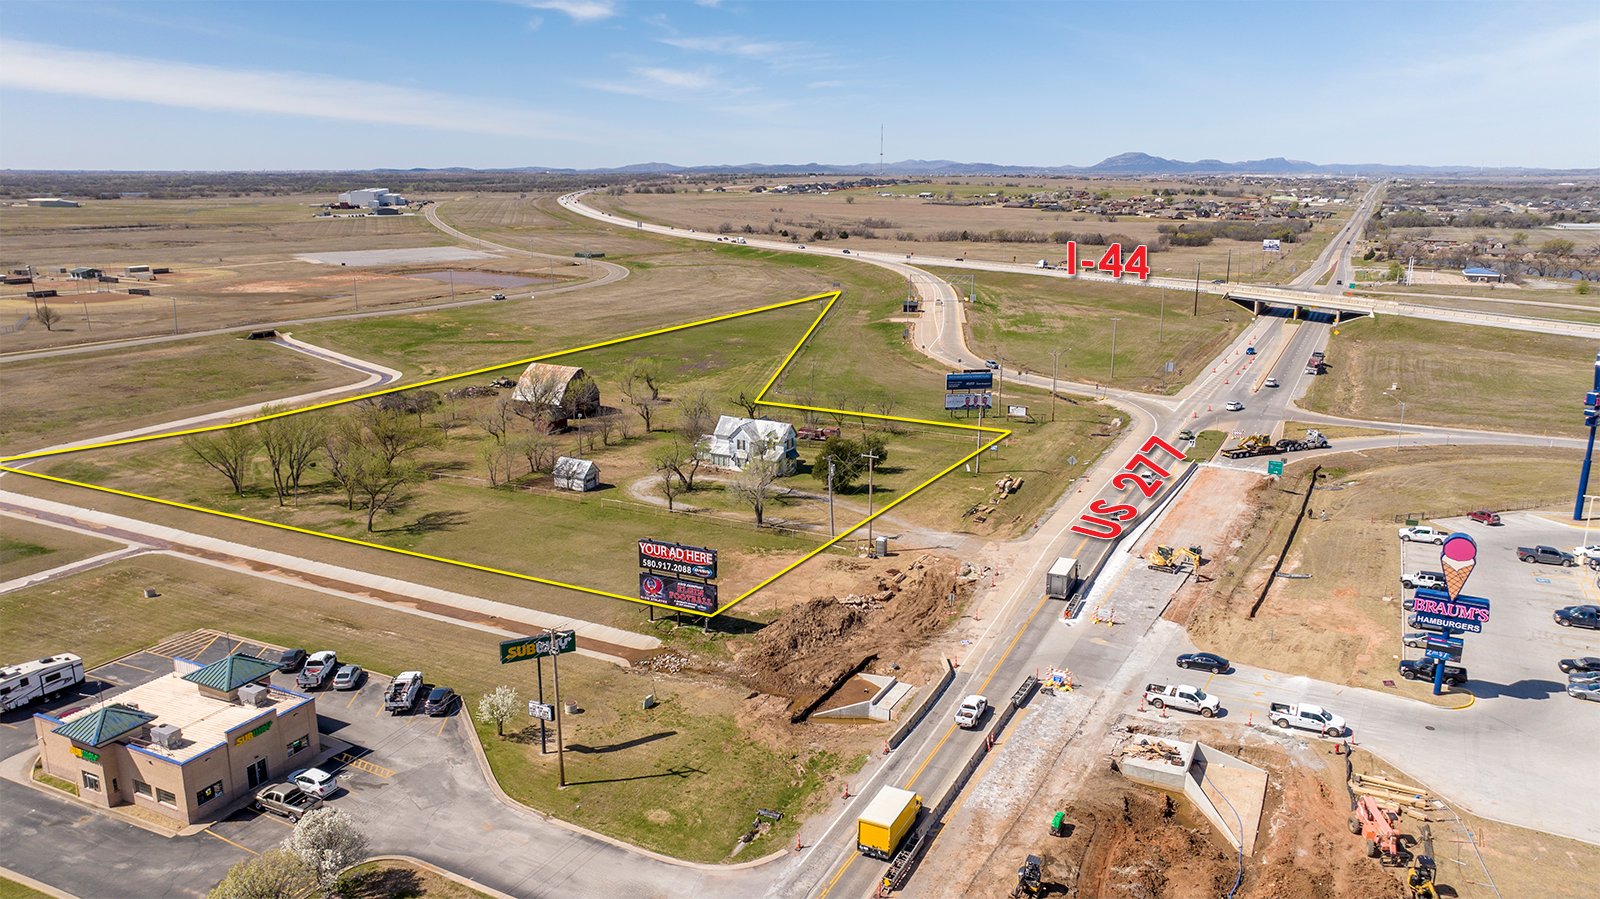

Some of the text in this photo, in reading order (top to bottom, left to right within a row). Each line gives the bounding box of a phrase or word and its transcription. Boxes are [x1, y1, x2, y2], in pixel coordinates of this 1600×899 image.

[639, 542, 713, 565] YOUR AD HERE
[643, 559, 691, 574] 580.917.2088
[669, 591, 713, 606] FOOTBALL
[1413, 598, 1489, 622] BRAUM'S
[1417, 616, 1480, 632] HAMBURGERS
[234, 720, 273, 746] SUBWAY
